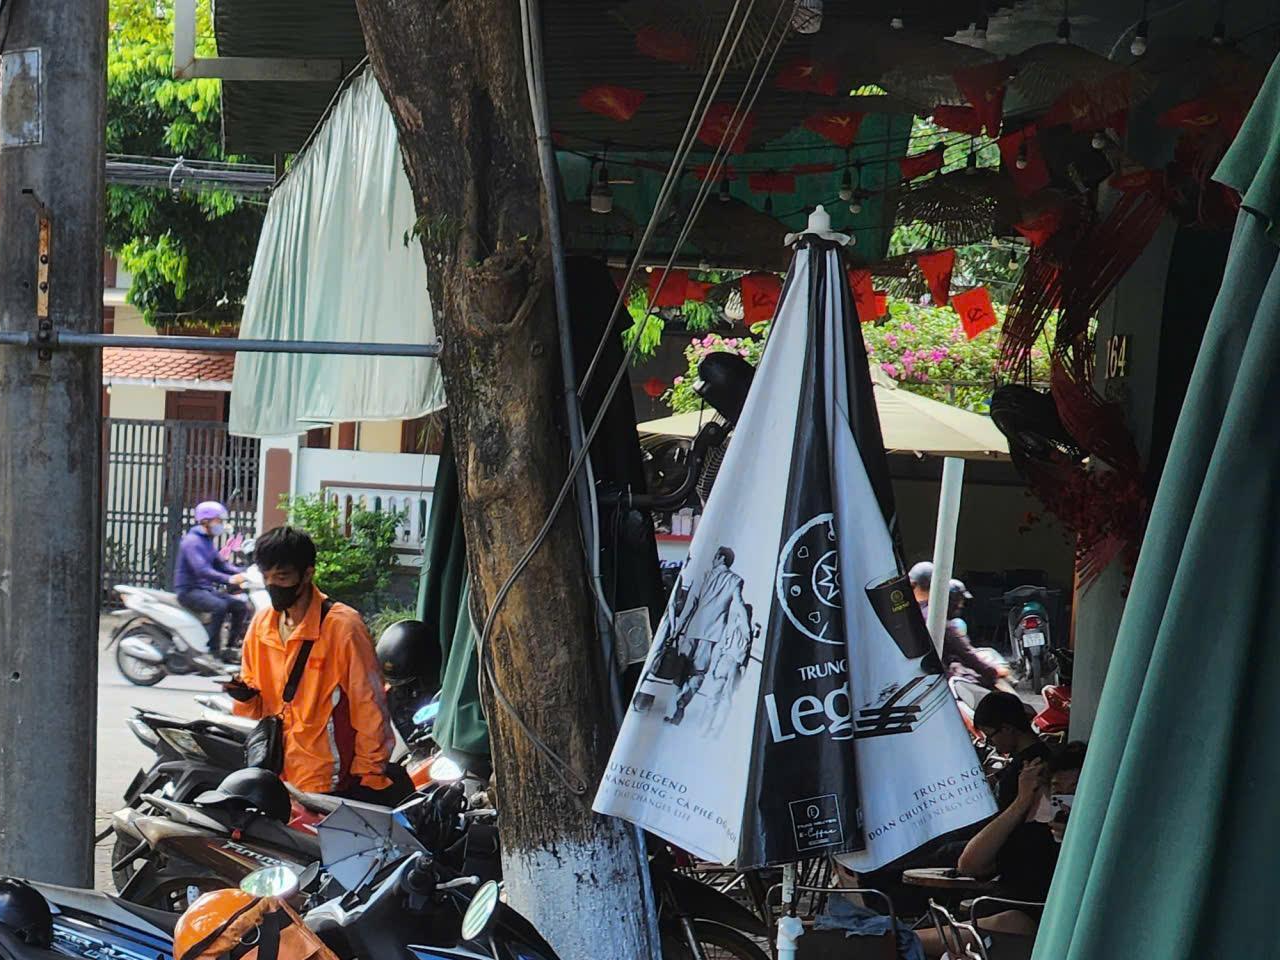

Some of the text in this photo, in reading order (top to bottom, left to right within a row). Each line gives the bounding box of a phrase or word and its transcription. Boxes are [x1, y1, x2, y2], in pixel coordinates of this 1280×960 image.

[1104, 335, 1126, 379] 164
[639, 768, 688, 795] LEGEND
[912, 775, 957, 801] TRUNG
